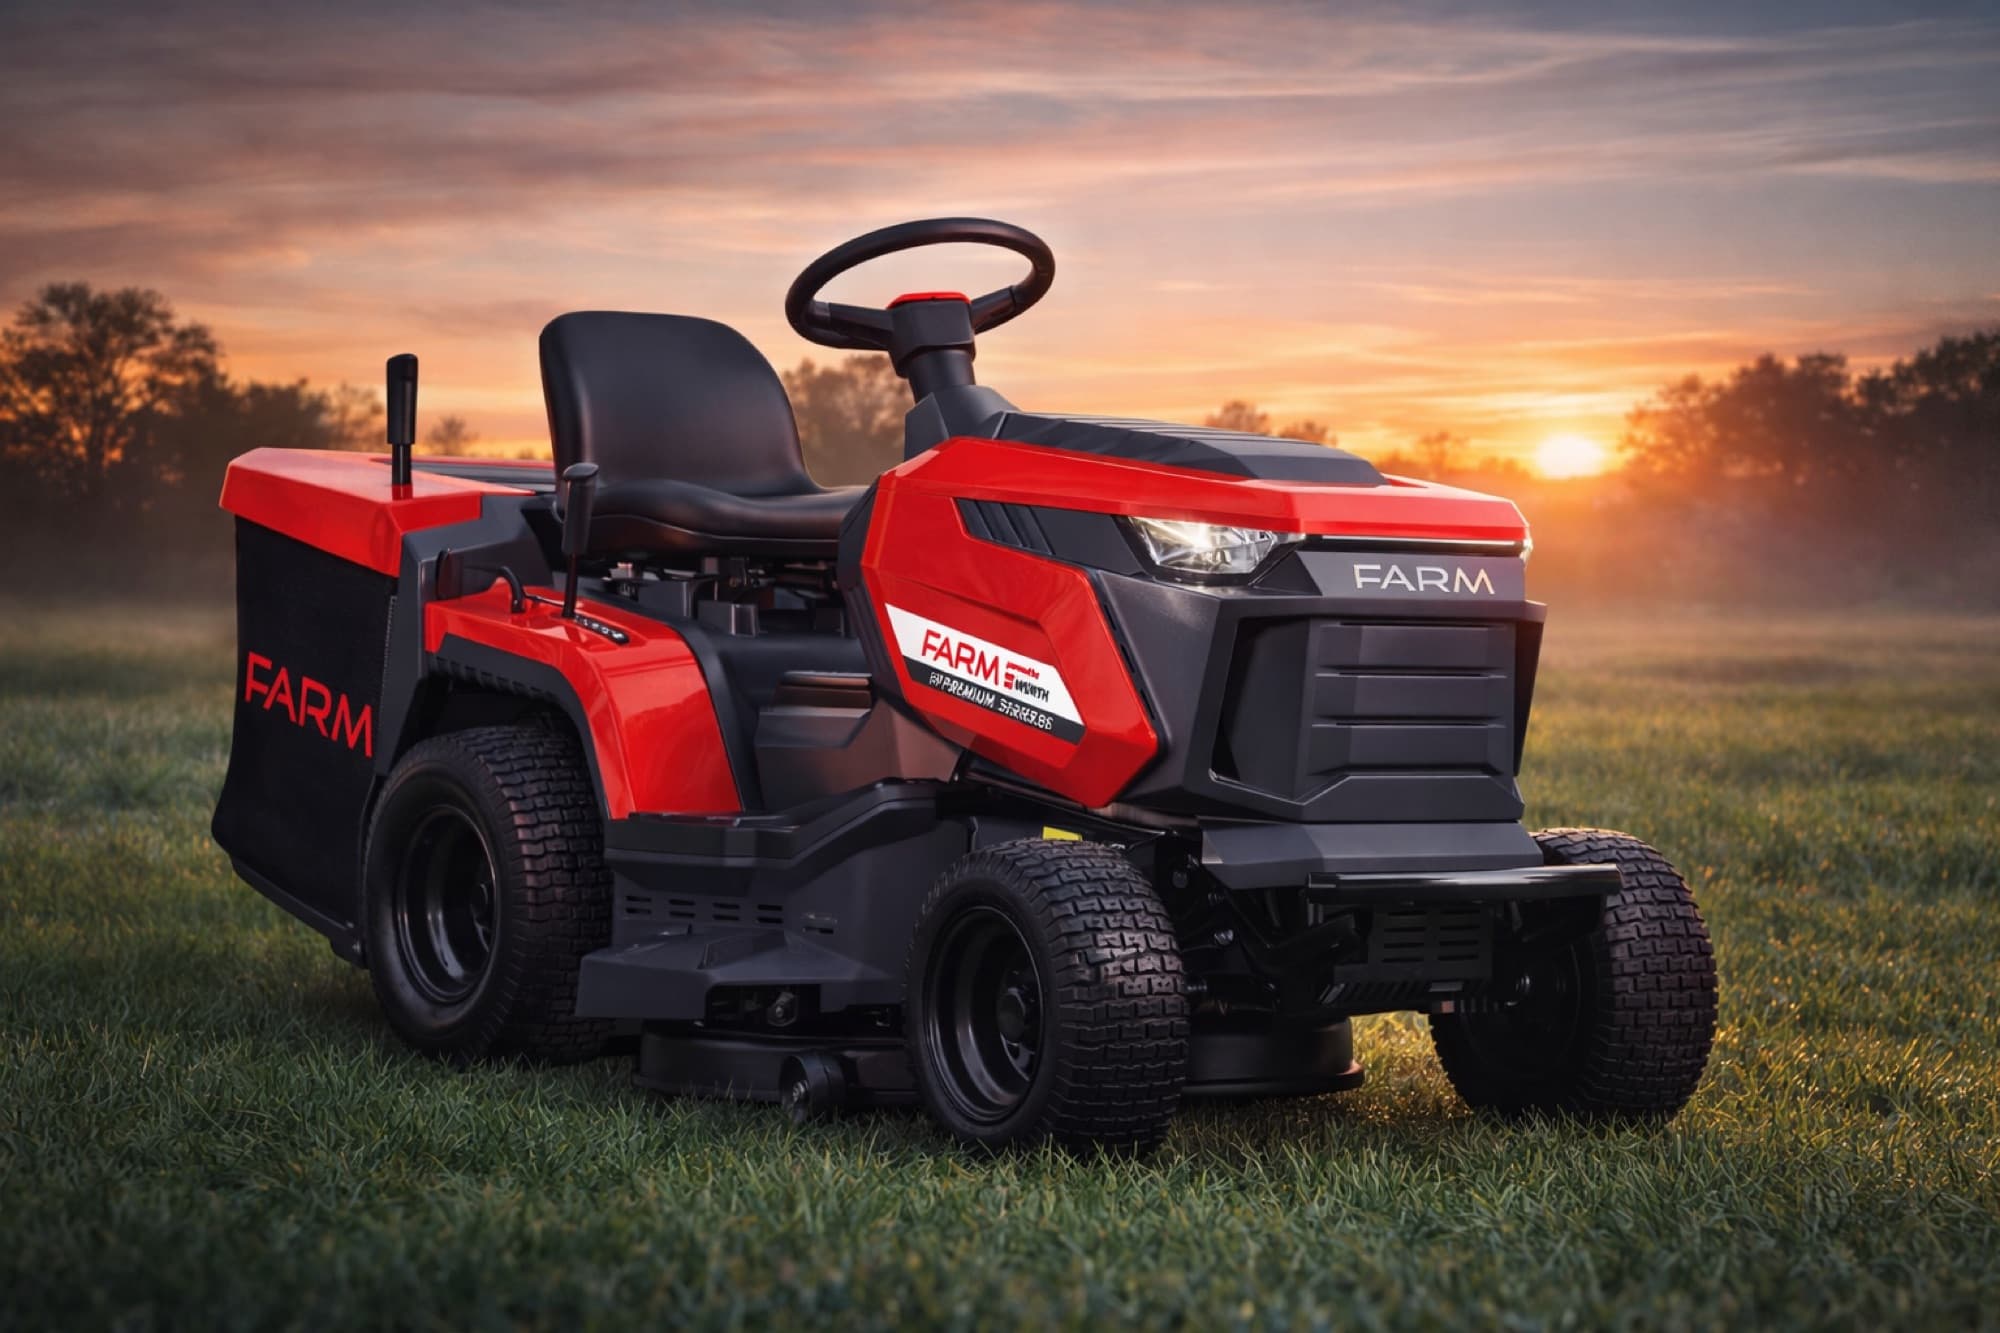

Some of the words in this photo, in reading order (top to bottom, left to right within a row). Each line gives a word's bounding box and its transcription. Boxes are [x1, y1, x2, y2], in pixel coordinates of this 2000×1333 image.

[1353, 563, 1496, 595] FARM
[922, 629, 999, 686] FARM
[244, 651, 373, 758] FARM
